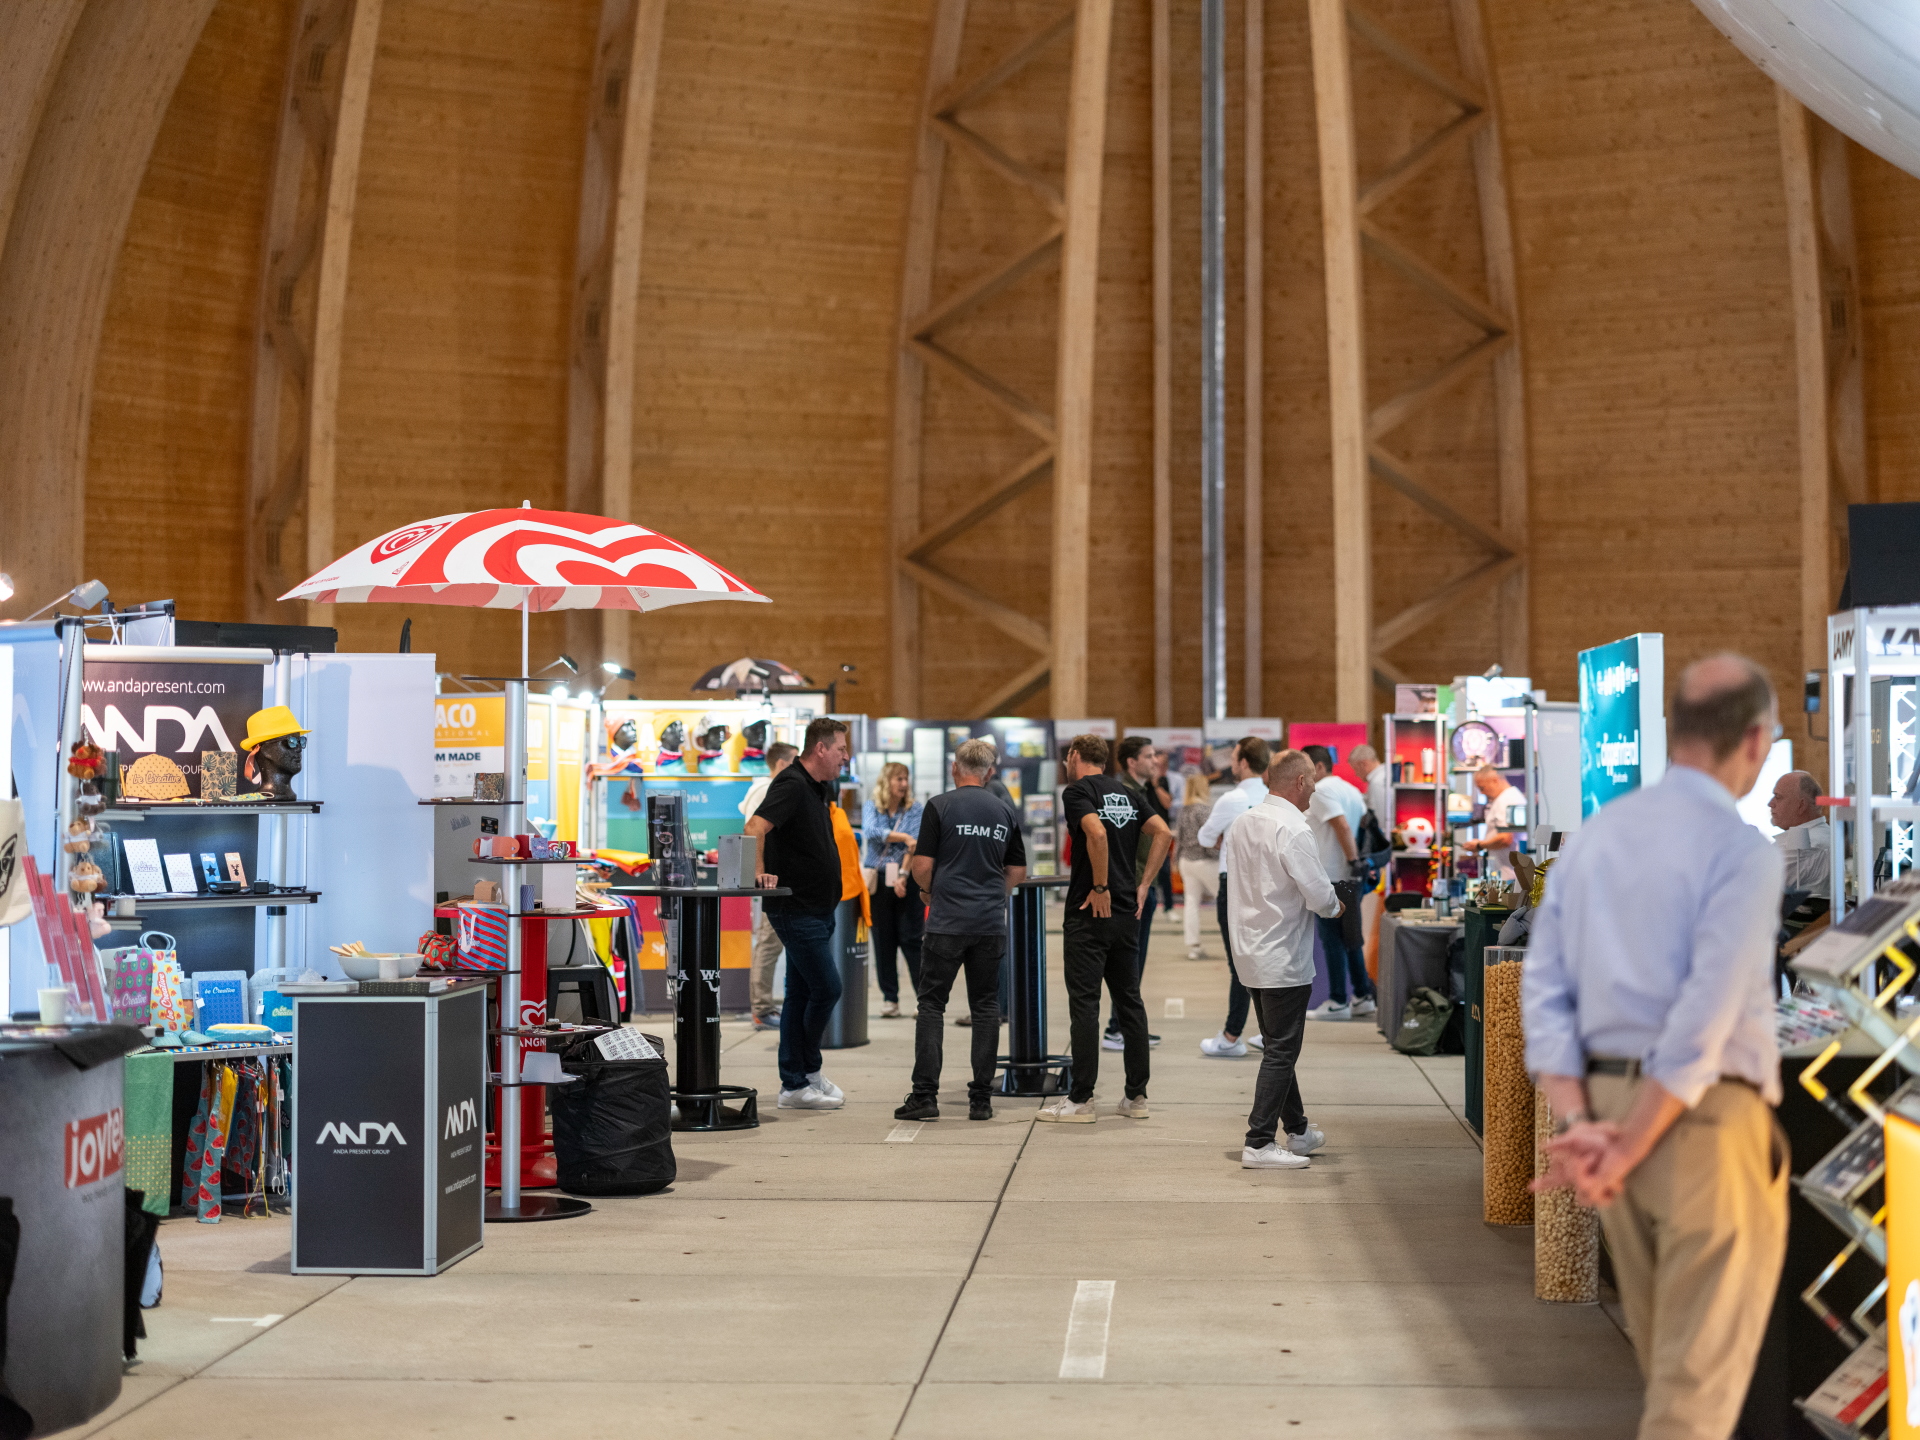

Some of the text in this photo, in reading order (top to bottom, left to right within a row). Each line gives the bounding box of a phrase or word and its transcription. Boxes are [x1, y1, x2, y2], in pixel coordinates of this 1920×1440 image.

[80, 703, 236, 753] ANDA
[448, 752, 481, 761] MADE
[956, 824, 991, 838] TEAM
[121, 992, 148, 1008] Creative
[158, 972, 175, 1021] be Creative
[204, 986, 236, 995] be Creative
[443, 1097, 478, 1141] ANDA
[315, 1121, 408, 1146] ANDA
